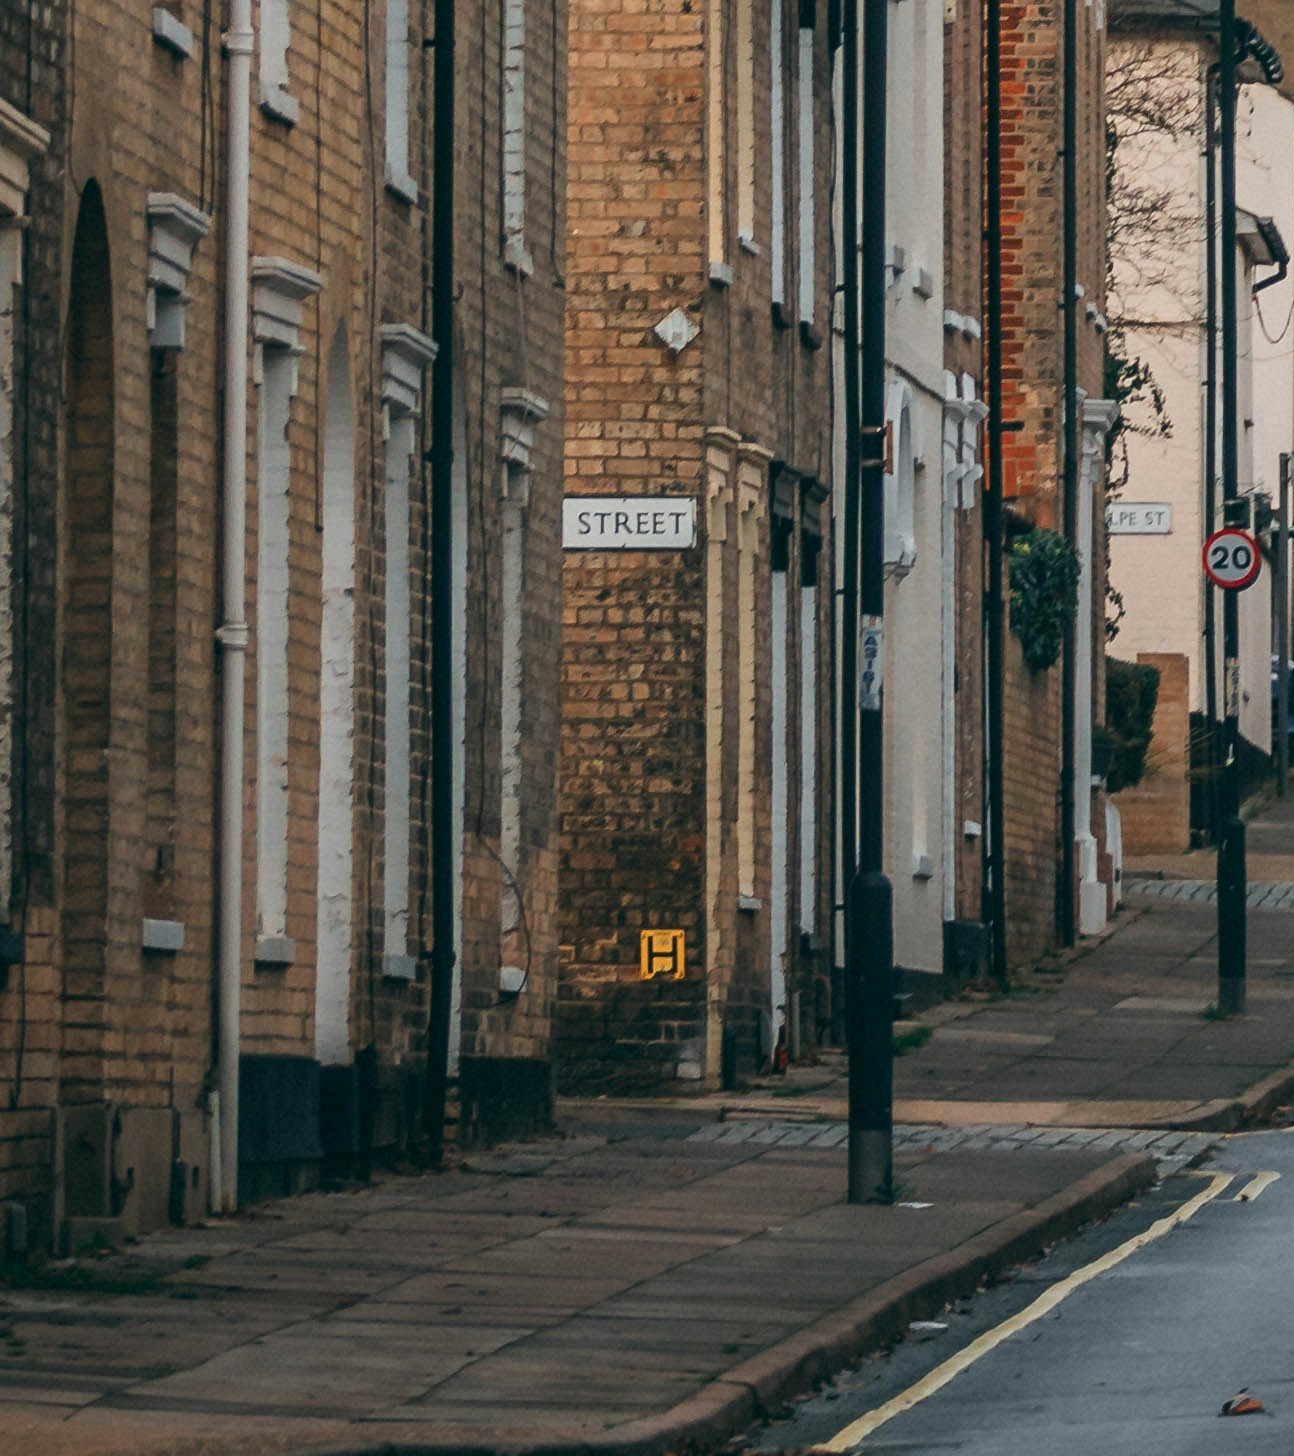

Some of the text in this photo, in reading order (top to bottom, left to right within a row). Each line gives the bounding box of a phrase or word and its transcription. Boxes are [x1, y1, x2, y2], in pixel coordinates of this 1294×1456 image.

[577, 511, 687, 535] STREET
[1144, 511, 1166, 526] ST
[1211, 545, 1251, 570] 20
